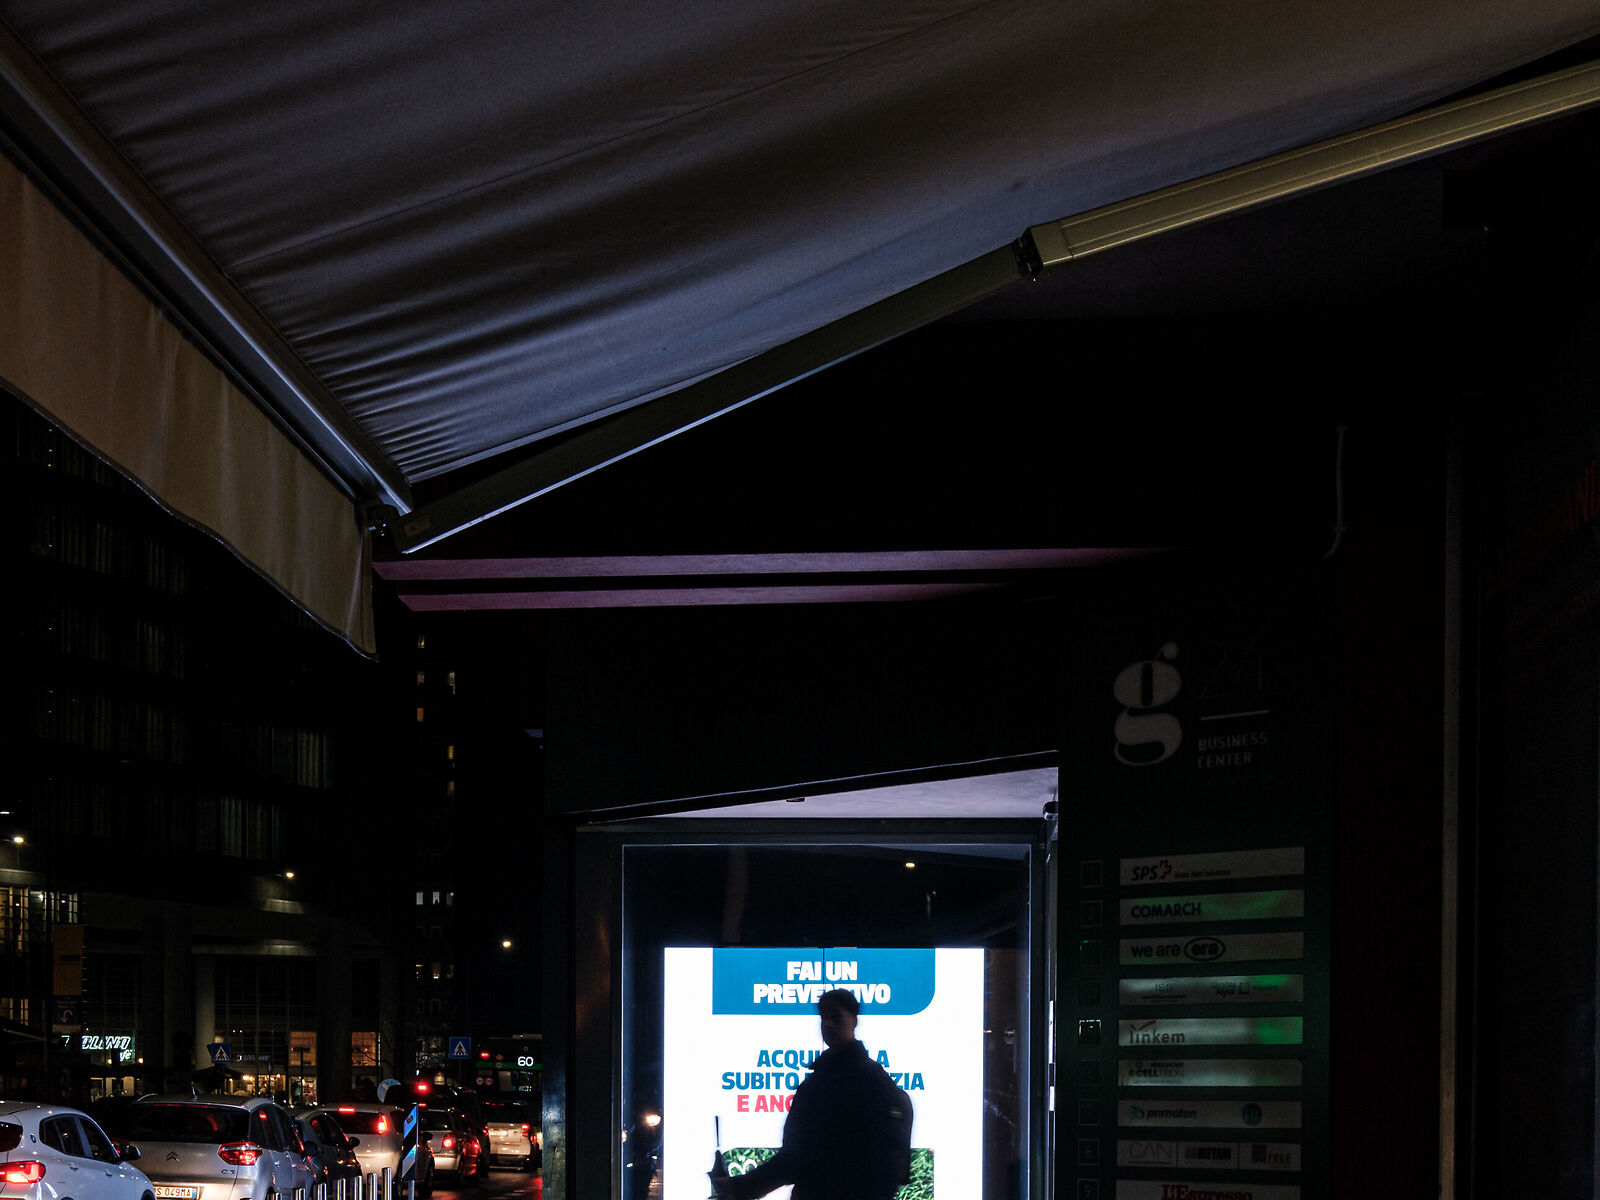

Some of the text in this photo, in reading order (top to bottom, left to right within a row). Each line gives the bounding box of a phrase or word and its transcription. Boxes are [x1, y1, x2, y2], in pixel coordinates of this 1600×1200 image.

[1197, 731, 1270, 751] BUSINESS
[1197, 751, 1253, 769] CENTER
[1131, 864, 1158, 881] SPS
[1130, 902, 1201, 919] COMARCH
[1131, 941, 1219, 957] we are era
[787, 961, 858, 981] FAI UN
[753, 983, 891, 1004] PREVEIVO
[1129, 1029, 1186, 1044] linkem
[517, 1056, 534, 1067] 60
[722, 1072, 800, 1090] SUBITO
[737, 1095, 749, 1112] E
